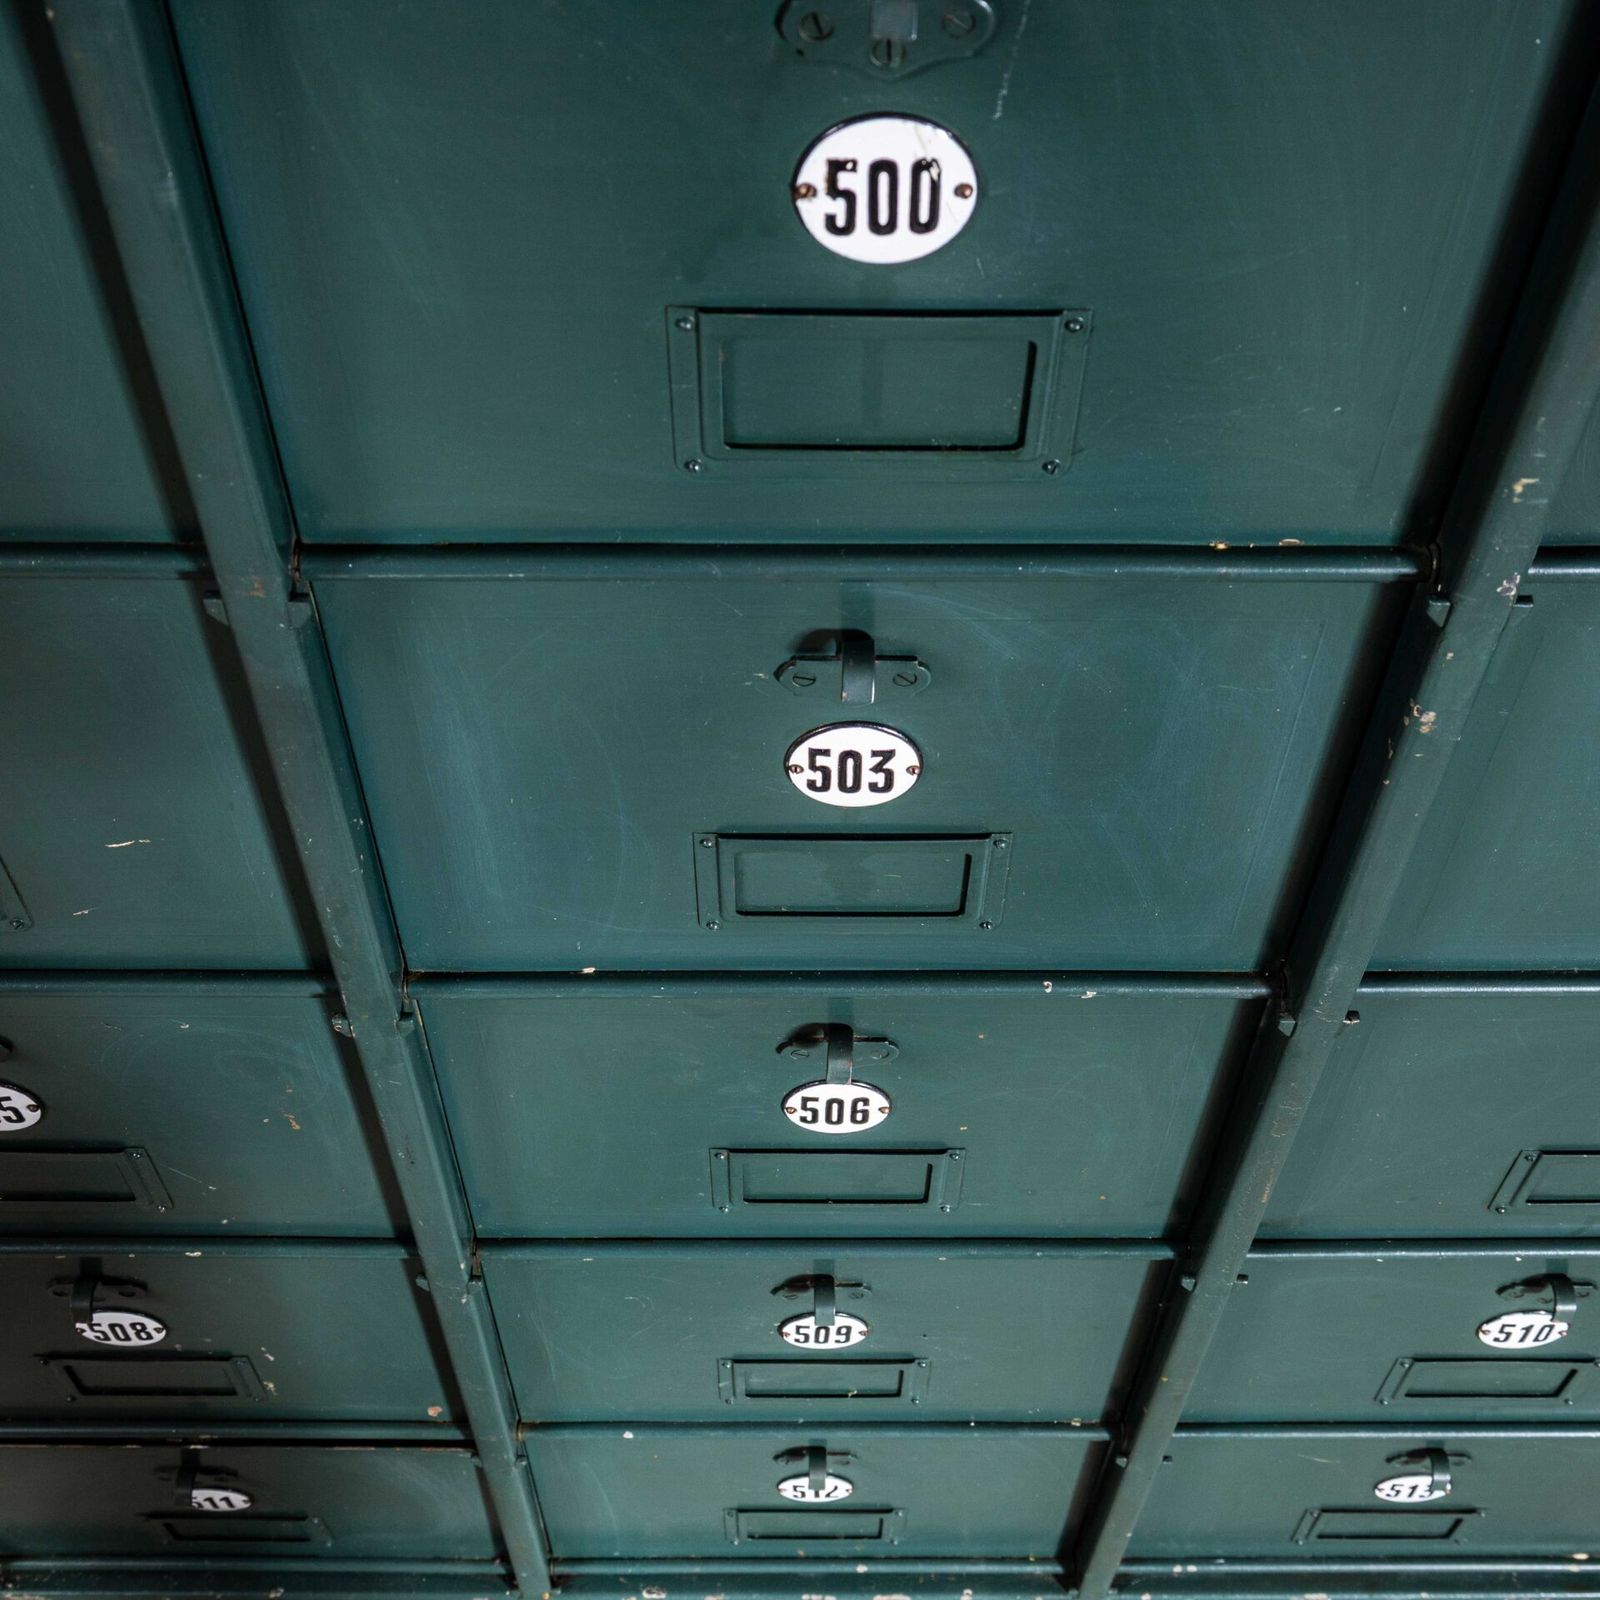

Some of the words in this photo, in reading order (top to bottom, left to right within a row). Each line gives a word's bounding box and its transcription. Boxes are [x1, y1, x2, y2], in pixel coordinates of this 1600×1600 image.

[825, 158, 941, 235] 500
[807, 748, 896, 794] 503
[800, 1096, 870, 1125] 506
[89, 1322, 154, 1342] 508
[794, 1325, 852, 1344] 509
[1493, 1324, 1556, 1343] 510
